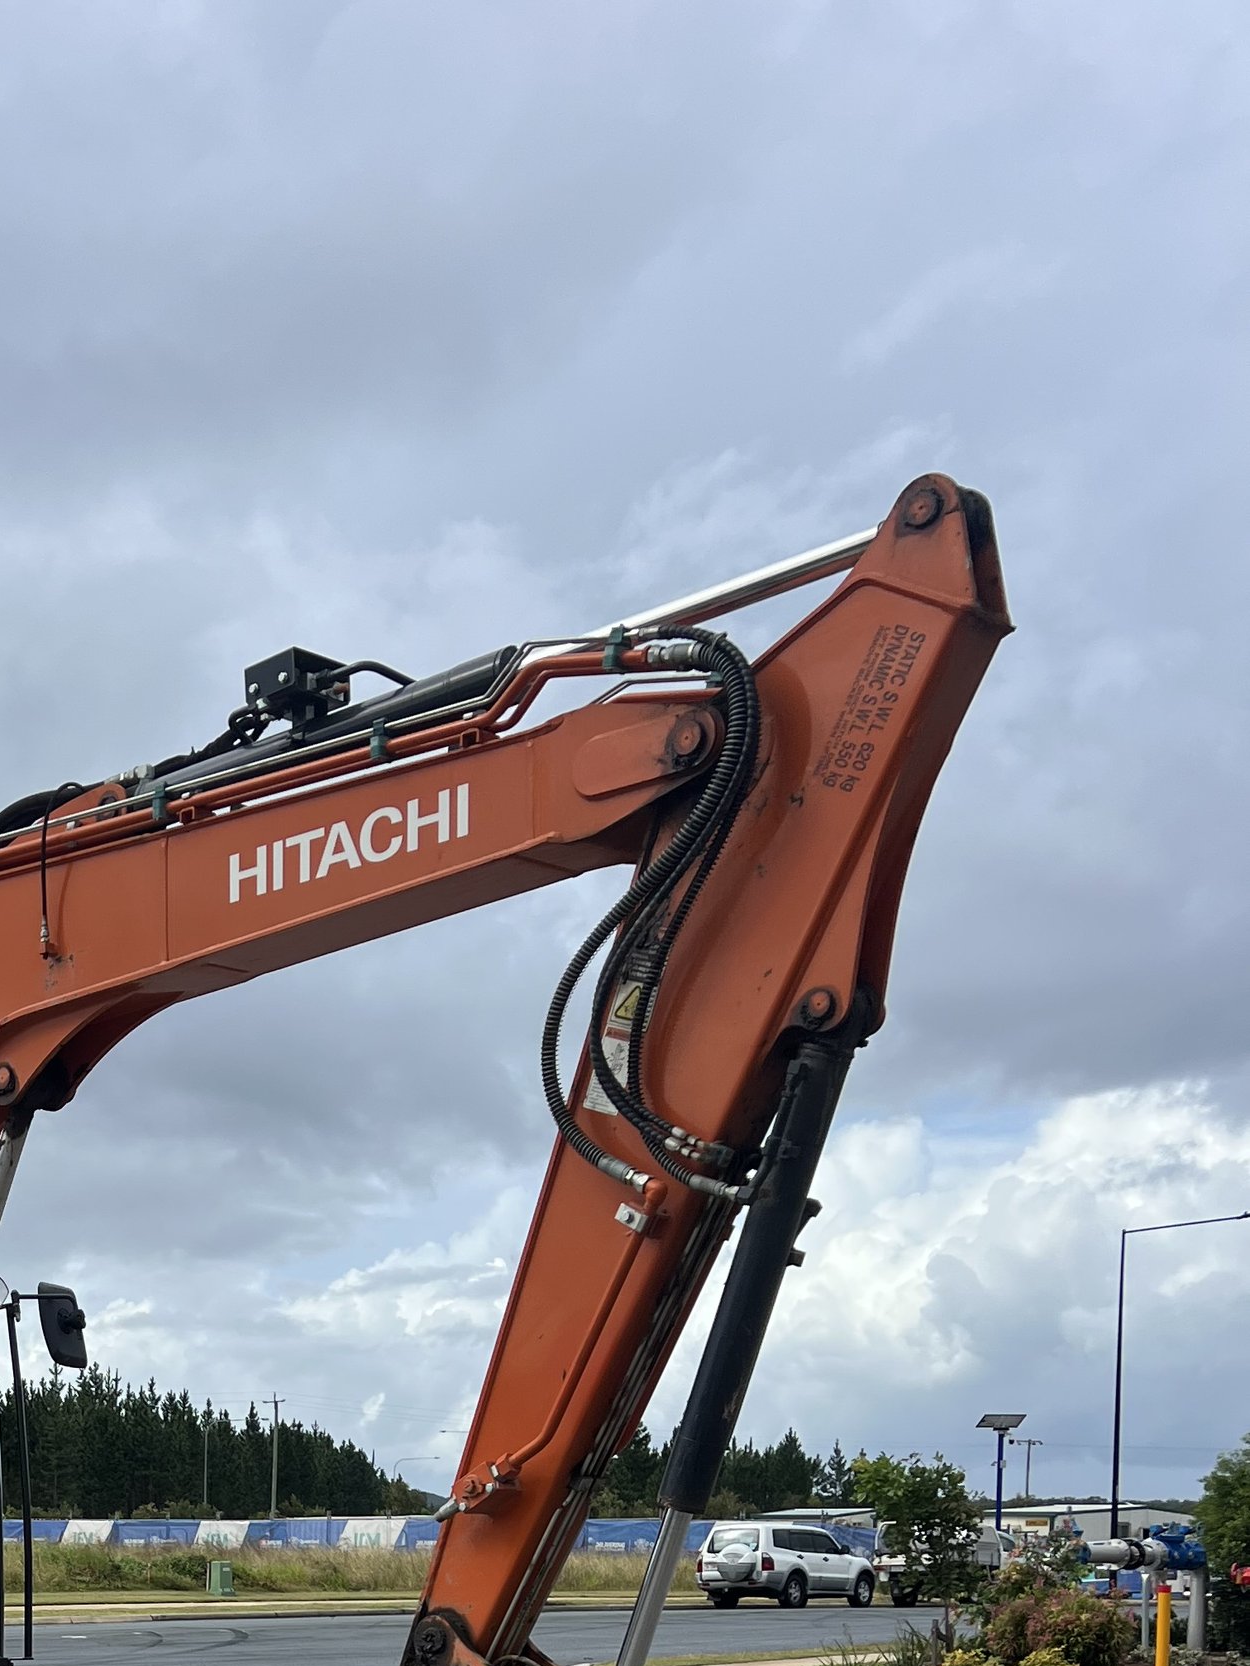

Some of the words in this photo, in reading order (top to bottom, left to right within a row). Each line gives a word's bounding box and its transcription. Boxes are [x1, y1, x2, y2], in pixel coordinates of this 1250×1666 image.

[868, 624, 910, 690] DYNAMIC
[891, 631, 926, 687] STATIC
[834, 741, 856, 768] 550
[852, 742, 875, 771] 620
[822, 772, 843, 788] kg
[840, 774, 860, 793] kg
[229, 783, 469, 903] HITACHI
